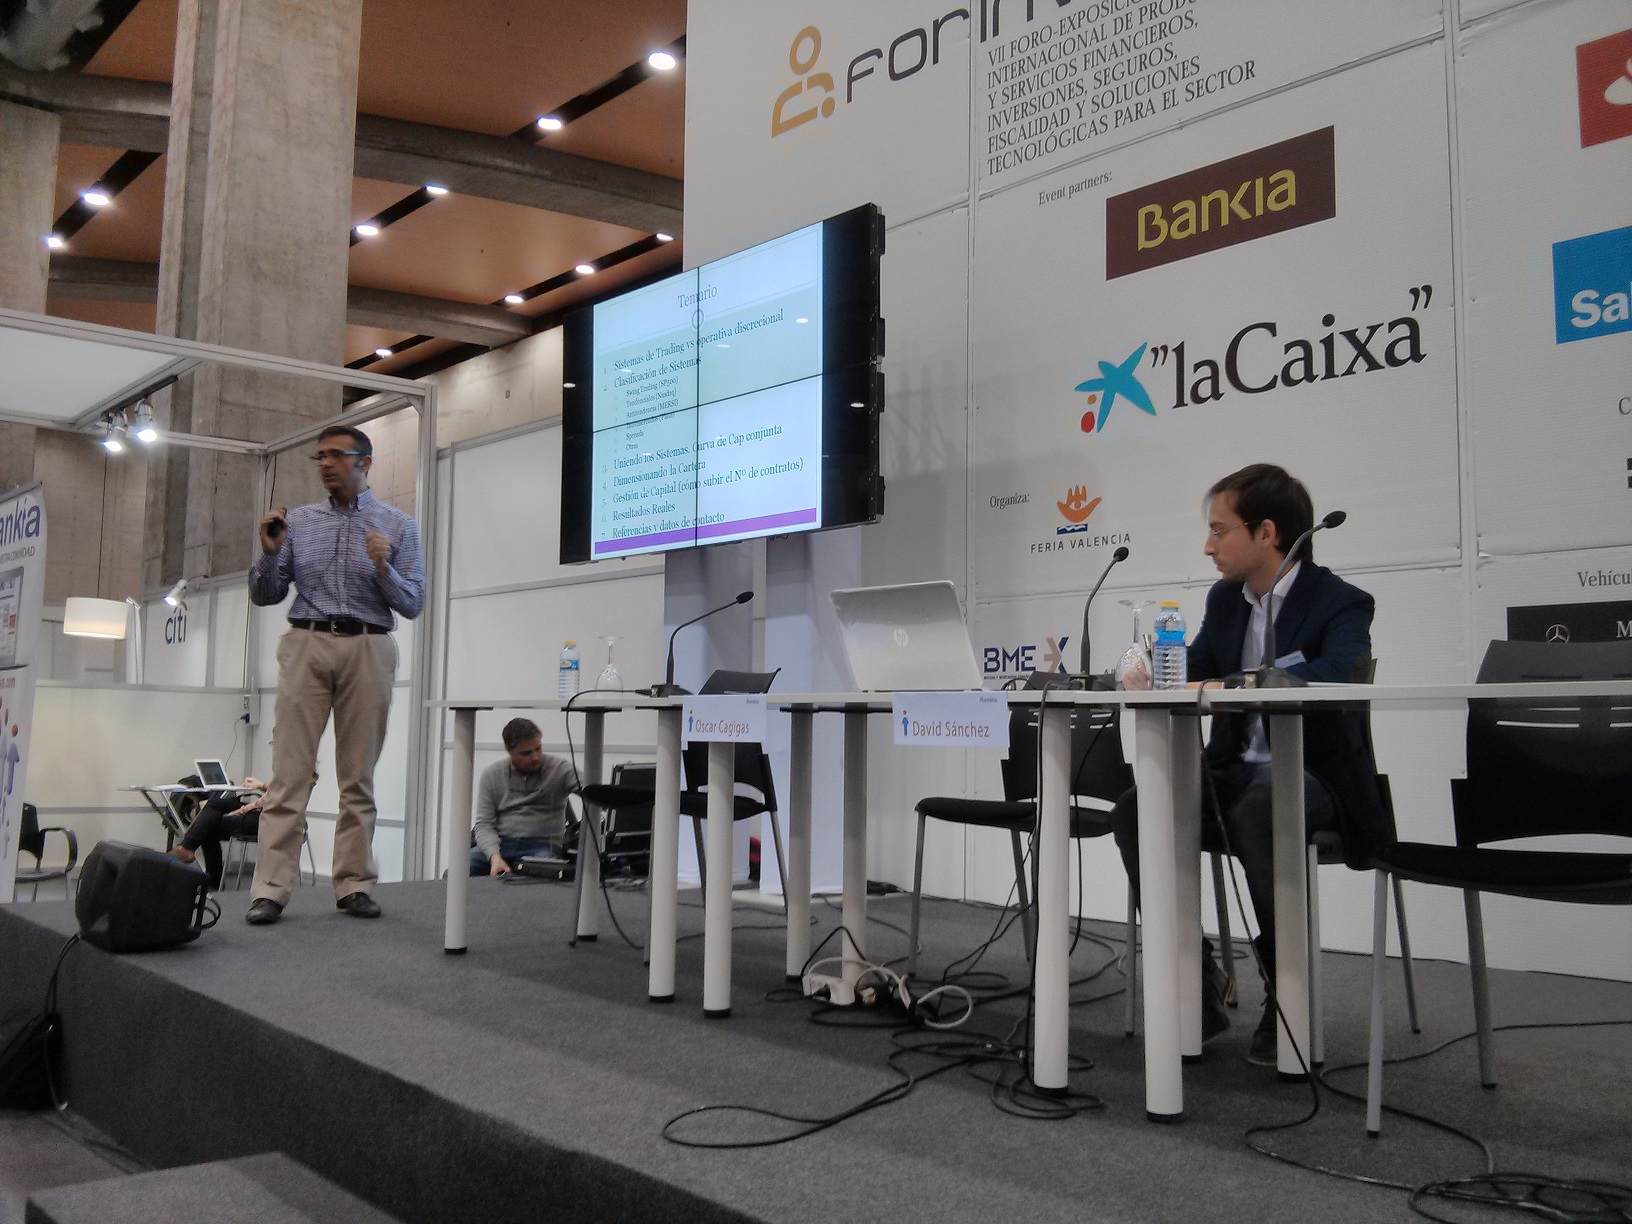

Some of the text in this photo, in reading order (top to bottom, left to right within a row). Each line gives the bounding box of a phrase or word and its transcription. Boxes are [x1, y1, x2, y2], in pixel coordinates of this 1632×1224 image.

[988, 0, 1196, 89] INTERNACIONAL DE PROD
[988, 45, 1005, 66] VII
[988, 10, 1198, 110] Y SERVICIOS FINANCIEROS,
[988, 42, 1177, 132] INVERSIONES, SEGUROS,
[987, 60, 1256, 176] TECNOLÓGICAS PARA EL SECTOR
[988, 56, 1200, 154] FISCALIDAD Y SOLUCIONES
[1039, 172, 1112, 206] Event partners:
[1137, 168, 1297, 252] Bankia
[678, 285, 718, 308] Temario
[1571, 281, 1632, 329] Sa
[614, 355, 644, 371] Sistemas
[646, 350, 654, 361] de
[656, 341, 684, 358] Trading
[686, 339, 695, 349] vs
[697, 328, 732, 347] operativa
[735, 308, 784, 335] discrecional
[614, 367, 657, 388] Clasificación
[659, 363, 668, 375] de
[670, 356, 701, 372] Sistemas
[626, 387, 640, 398] Swing
[641, 383, 658, 393] Trading
[614, 453, 642, 469] Uniendo
[644, 452, 654, 463] los
[717, 436, 726, 447] de
[728, 433, 744, 446] Cap
[746, 425, 782, 441] conjunta
[613, 490, 639, 503] Gestión
[640, 487, 649, 498] de
[650, 481, 676, 498] Capital
[678, 479, 701, 493] (cómo
[703, 473, 725, 488] subir
[725, 470, 733, 483] el
[748, 466, 759, 479] de
[760, 457, 804, 477] contratos)
[614, 466, 668, 487] Dimensionando
[670, 464, 677, 476] la
[678, 460, 706, 474] Cartera
[613, 505, 650, 520] Resultados
[652, 501, 676, 514] Reales
[989, 493, 1030, 510] Organiza:
[613, 523, 652, 538] Referencias
[654, 525, 659, 534] y
[660, 519, 680, 531] datos
[681, 516, 691, 527] de
[692, 512, 725, 526] contacto
[1030, 533, 1131, 554] FERIA VALENCIA
[165, 608, 187, 645] citi
[695, 719, 750, 738] Oscar Cagigas
[912, 720, 990, 738] David Sánchez
